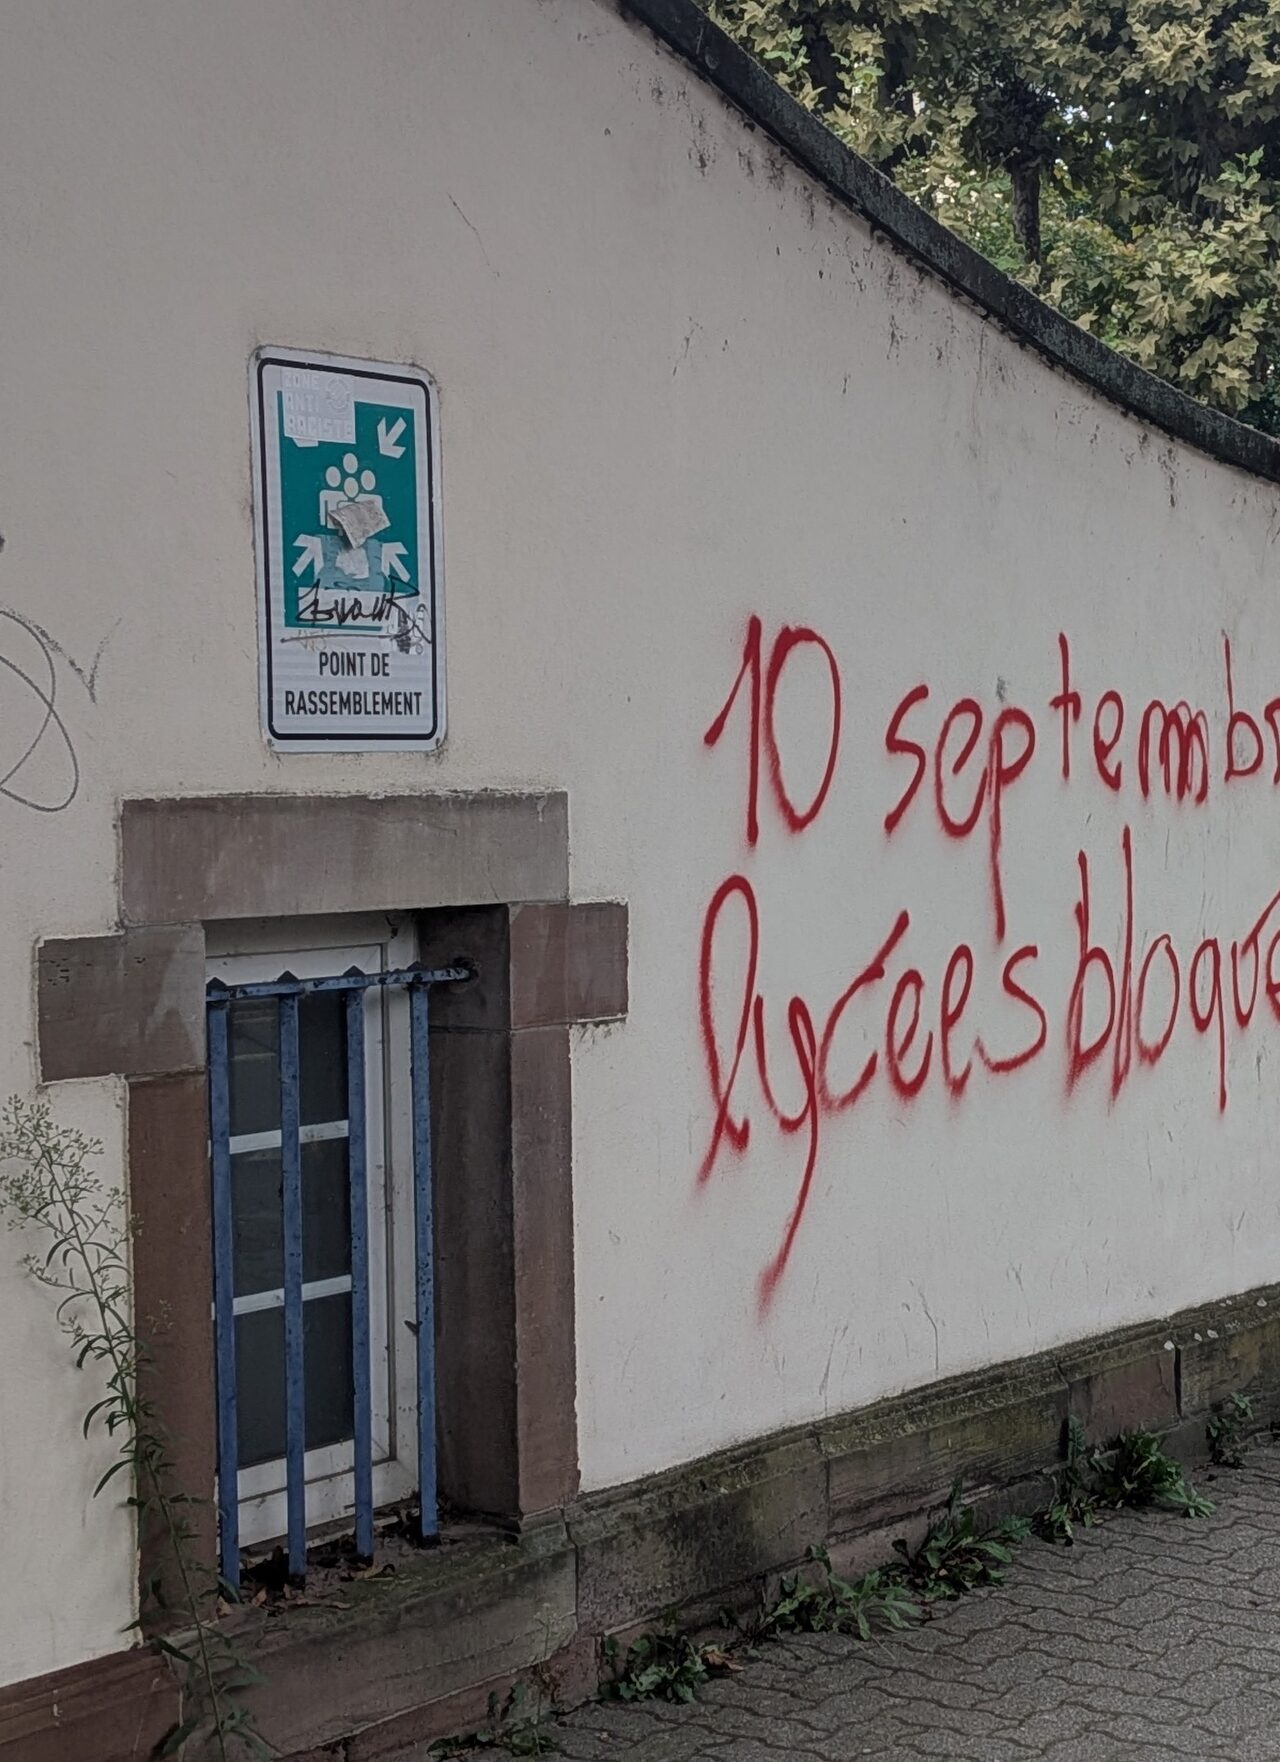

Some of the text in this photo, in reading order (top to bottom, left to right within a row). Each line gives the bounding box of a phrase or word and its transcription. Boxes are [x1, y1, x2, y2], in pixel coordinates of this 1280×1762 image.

[319, 651, 390, 677] POINT DE
[285, 690, 423, 716] RASSEMBLEMENT
[704, 614, 842, 847] 10
